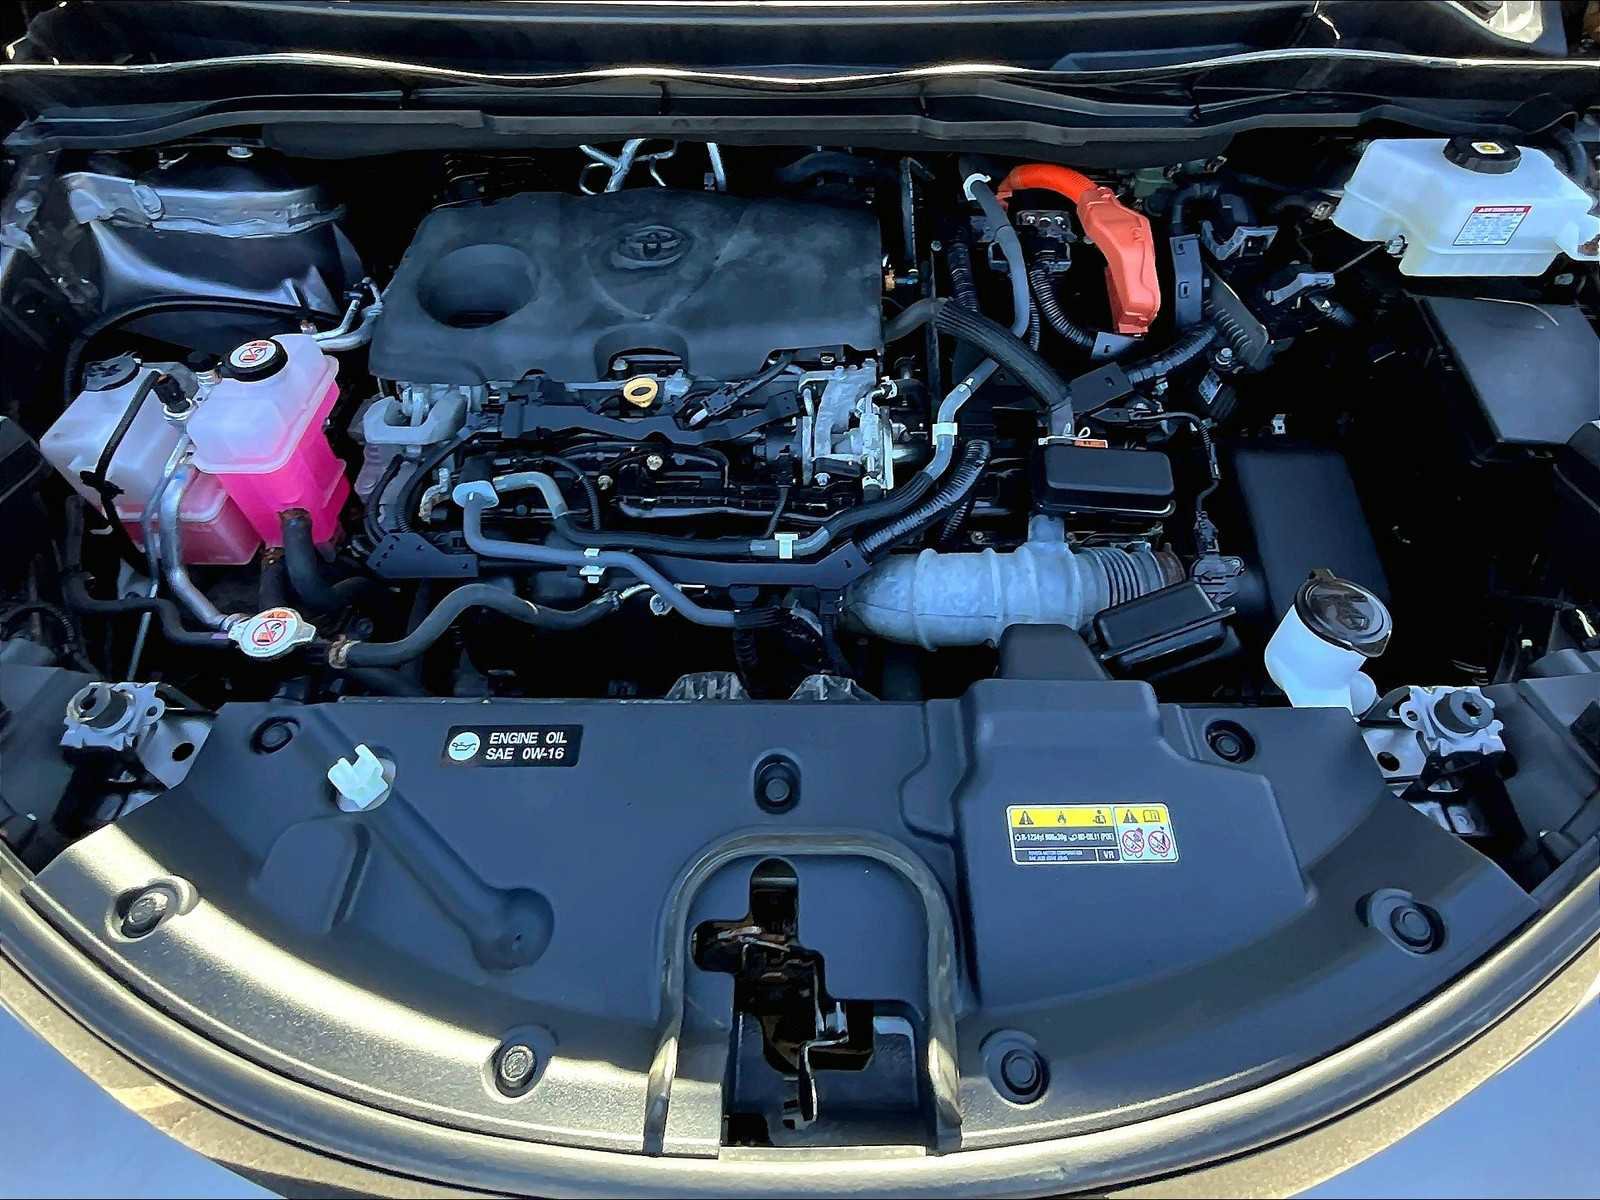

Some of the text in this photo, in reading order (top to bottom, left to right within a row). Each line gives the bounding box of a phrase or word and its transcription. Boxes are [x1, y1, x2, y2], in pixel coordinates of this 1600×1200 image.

[489, 731, 567, 744] ENGINE OIL
[485, 747, 565, 760] SAE 0W-16
[1103, 850, 1114, 859] VR
